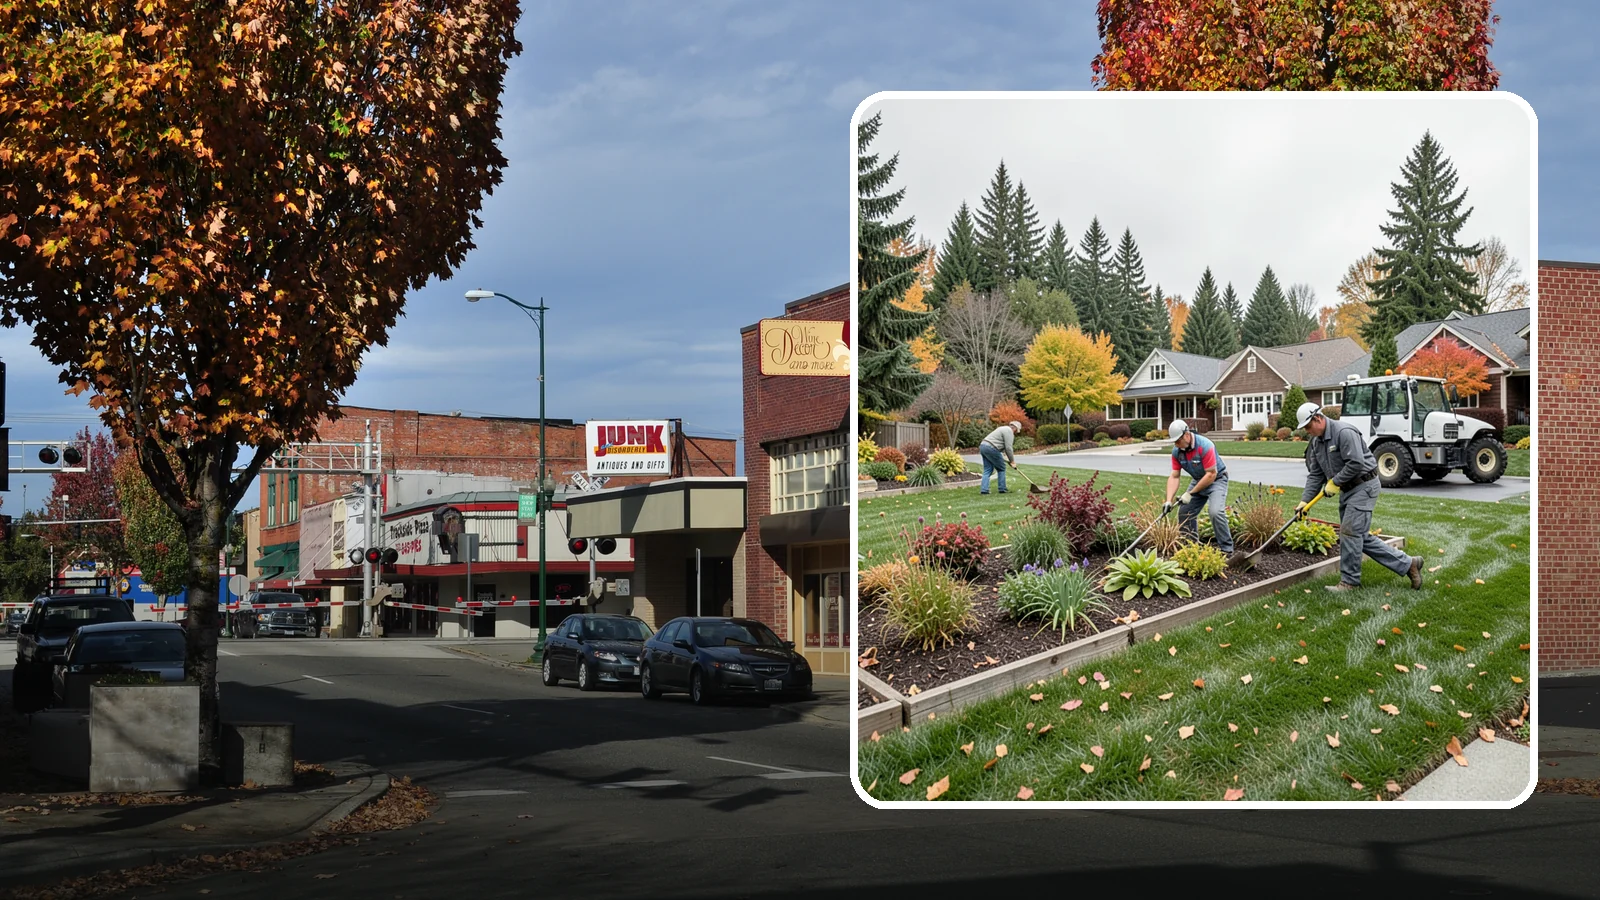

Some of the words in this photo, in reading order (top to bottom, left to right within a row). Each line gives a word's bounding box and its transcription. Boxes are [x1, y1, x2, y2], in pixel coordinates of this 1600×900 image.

[595, 425, 665, 457] JUNK
[607, 446, 646, 454] DISORDERLY
[597, 461, 628, 470] ANTIQUES
[631, 461, 644, 470] AND
[647, 460, 665, 469] GIFTS
[414, 519, 429, 535] Pizza
